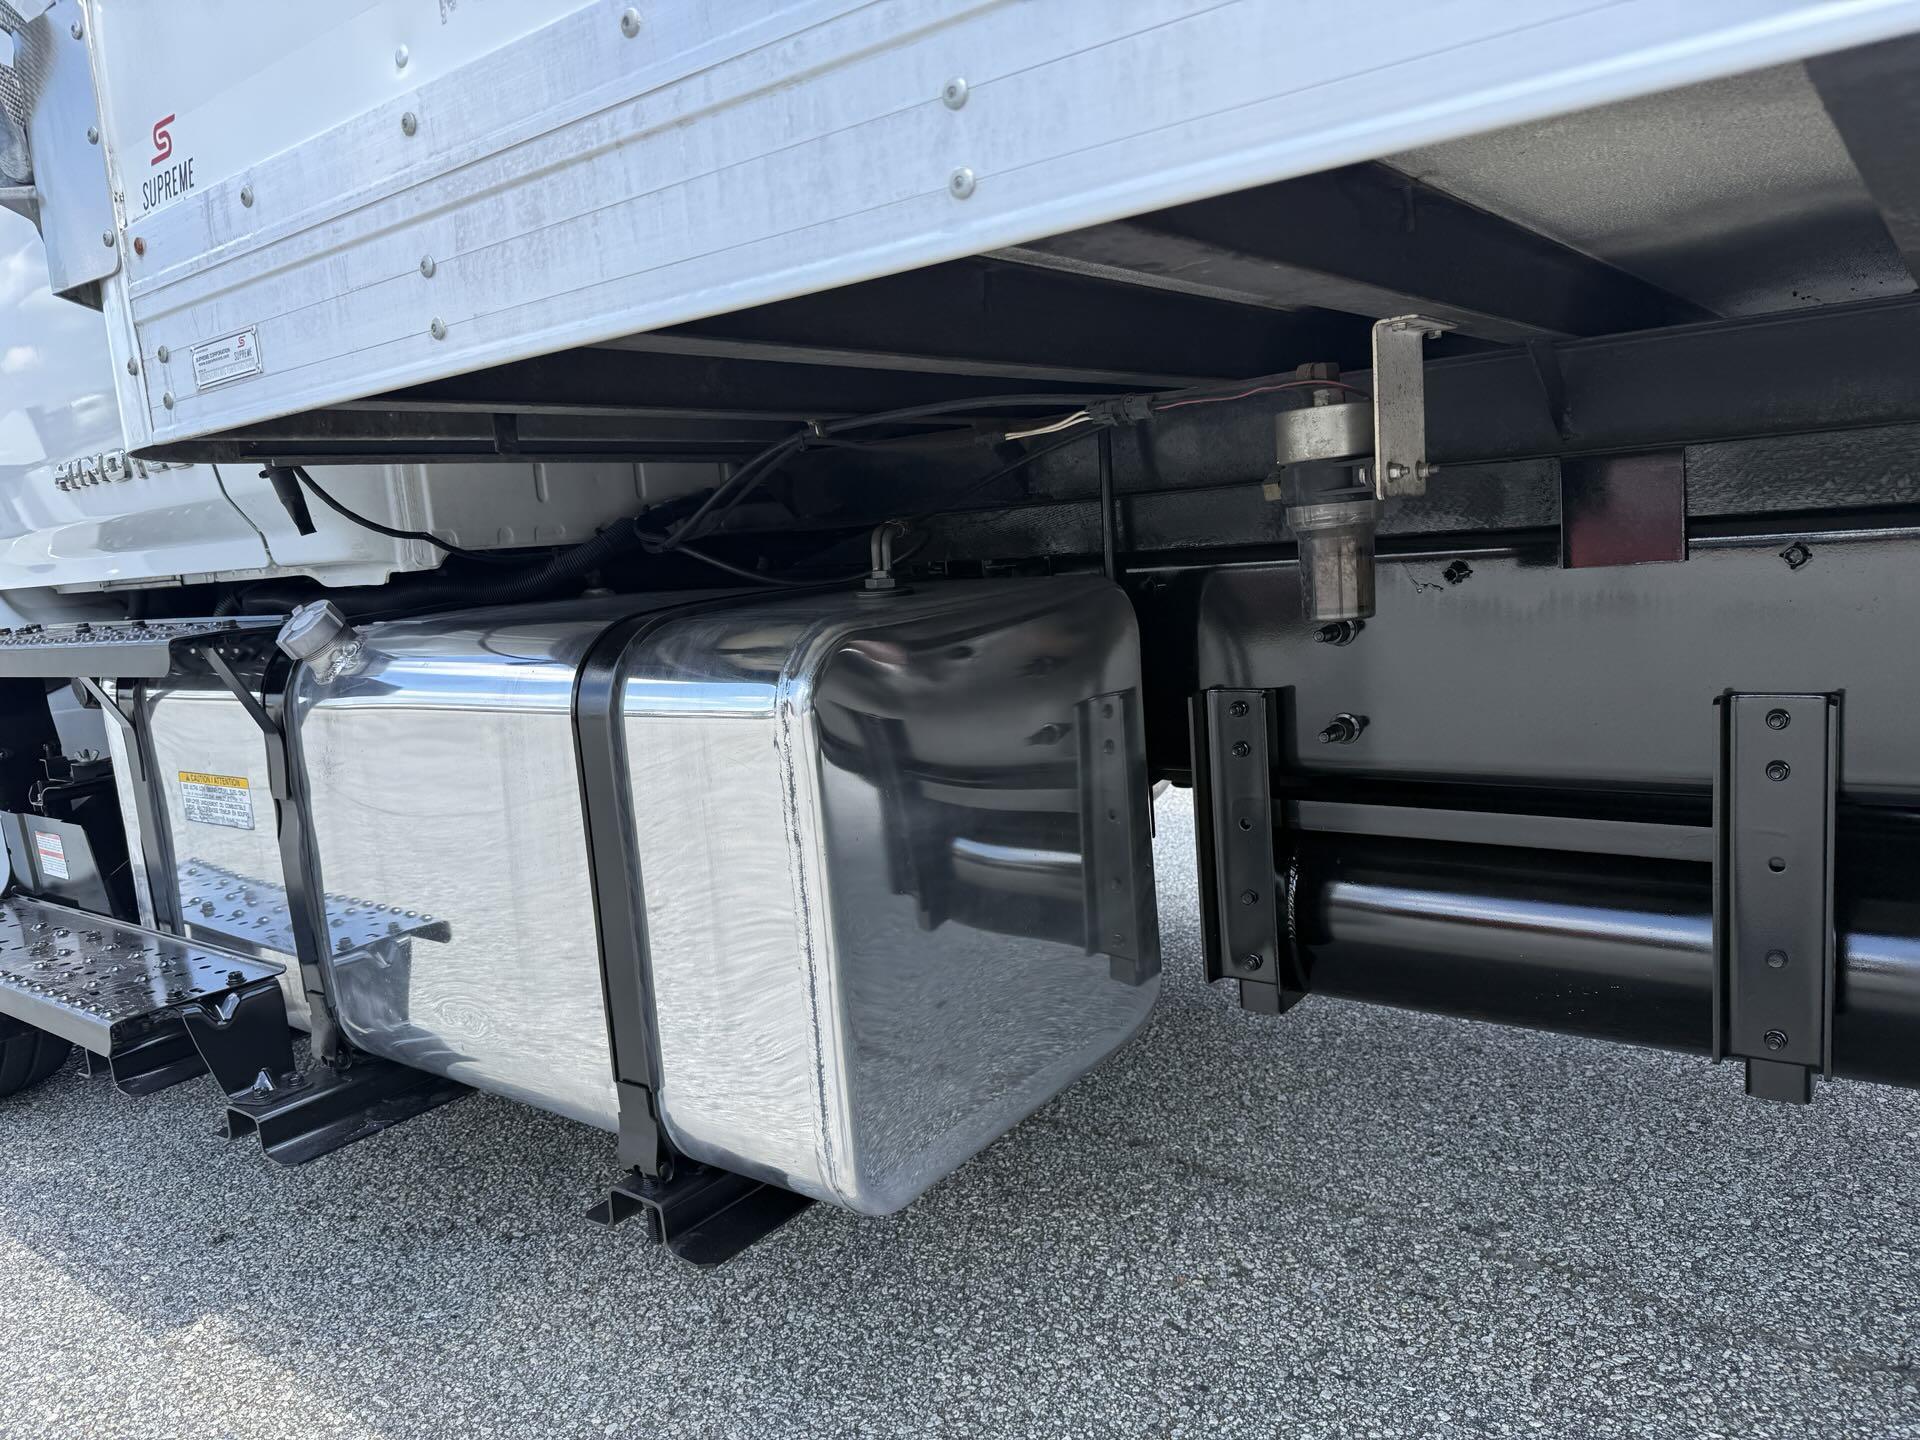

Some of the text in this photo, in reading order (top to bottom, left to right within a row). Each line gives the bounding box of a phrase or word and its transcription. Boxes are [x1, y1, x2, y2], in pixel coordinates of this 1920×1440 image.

[143, 158, 194, 211] SUPREME
[234, 347, 252, 361] SUPREME
[55, 448, 133, 492] HINO
[190, 774, 210, 784] CAUTION
[213, 777, 241, 787] ATTENTION
